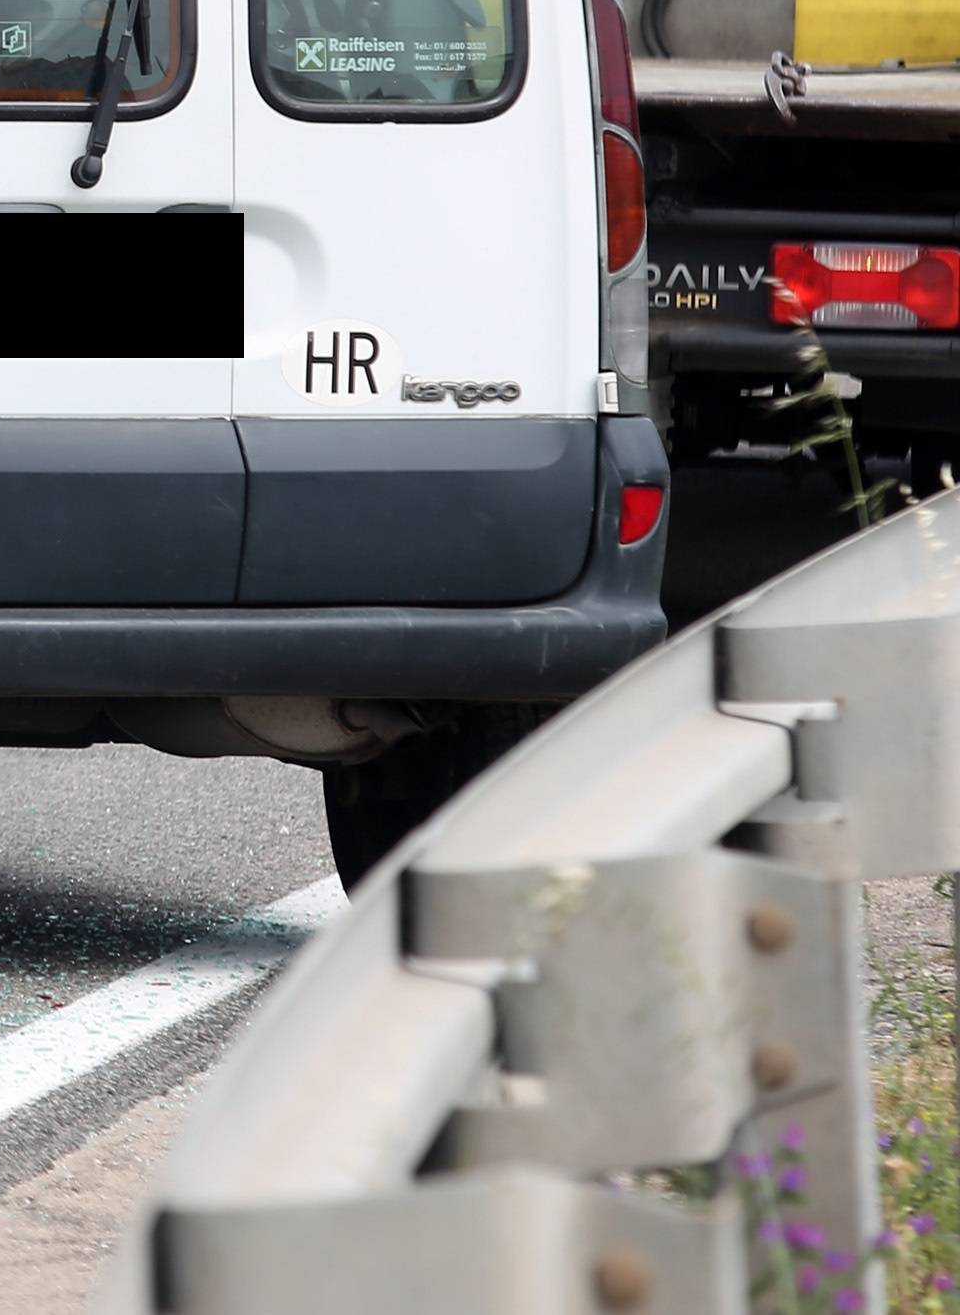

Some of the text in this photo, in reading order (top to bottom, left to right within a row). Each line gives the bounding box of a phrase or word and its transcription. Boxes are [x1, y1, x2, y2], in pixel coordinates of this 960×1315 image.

[329, 37, 405, 52] Raiffeisen
[330, 57, 396, 72] LEASING
[676, 292, 717, 310] HPI
[305, 331, 380, 394] HR
